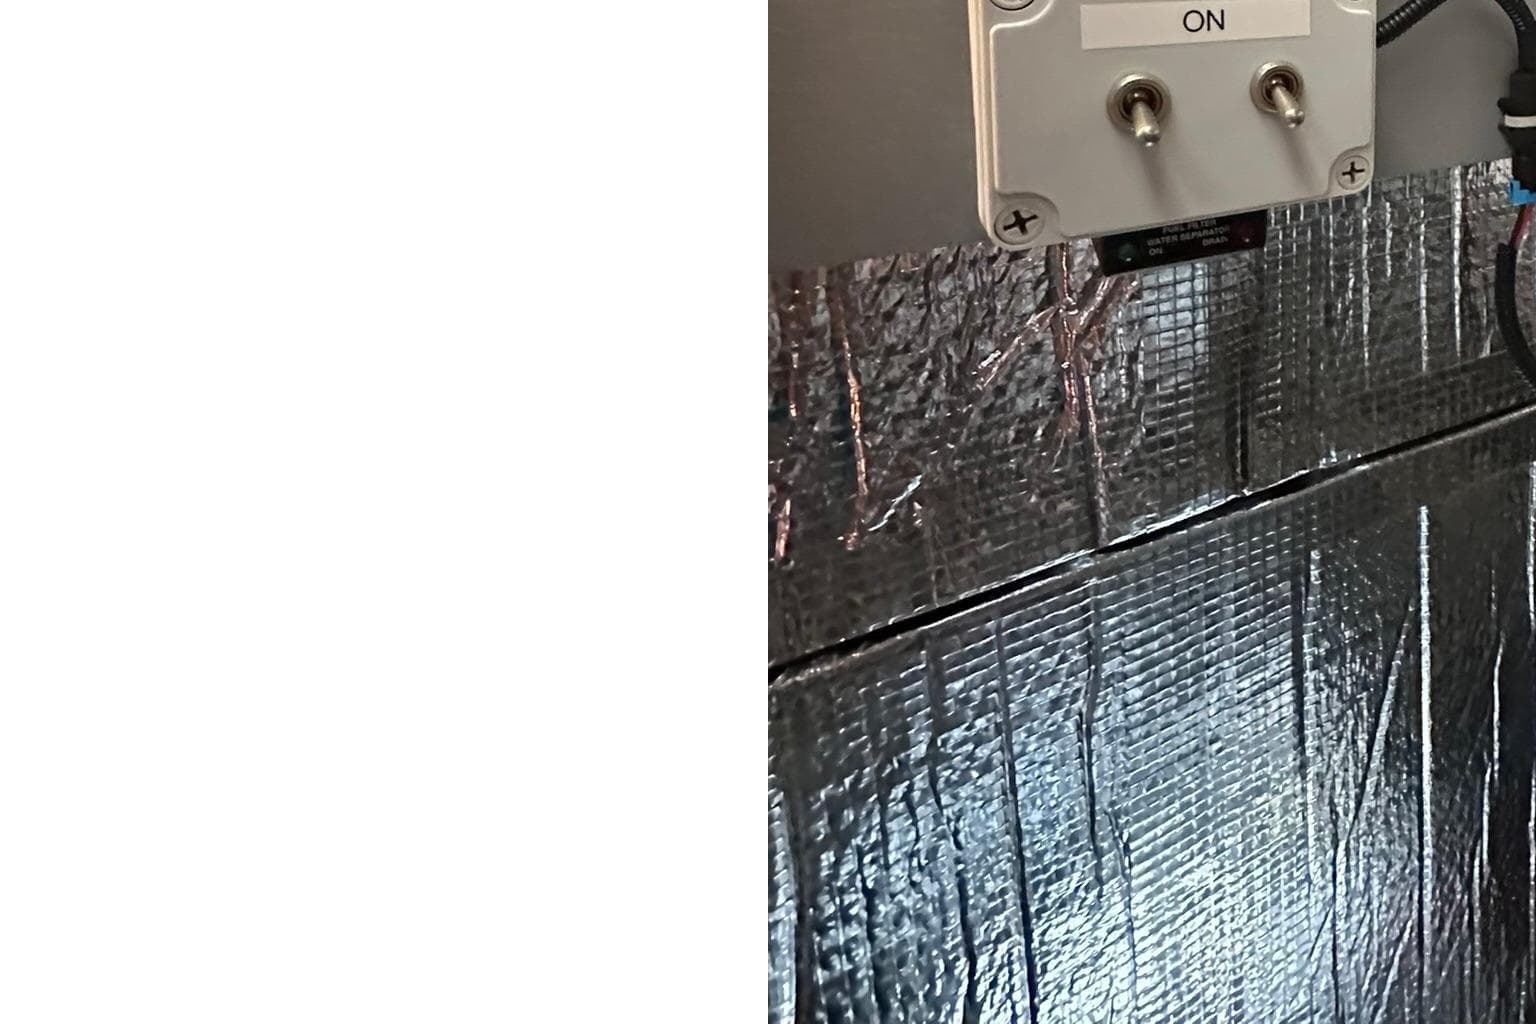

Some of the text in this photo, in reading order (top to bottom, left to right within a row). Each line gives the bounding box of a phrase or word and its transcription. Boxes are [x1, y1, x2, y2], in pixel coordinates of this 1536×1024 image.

[1182, 9, 1225, 33] ON
[1147, 232, 1178, 247] WATER
[1149, 247, 1163, 256] ON
